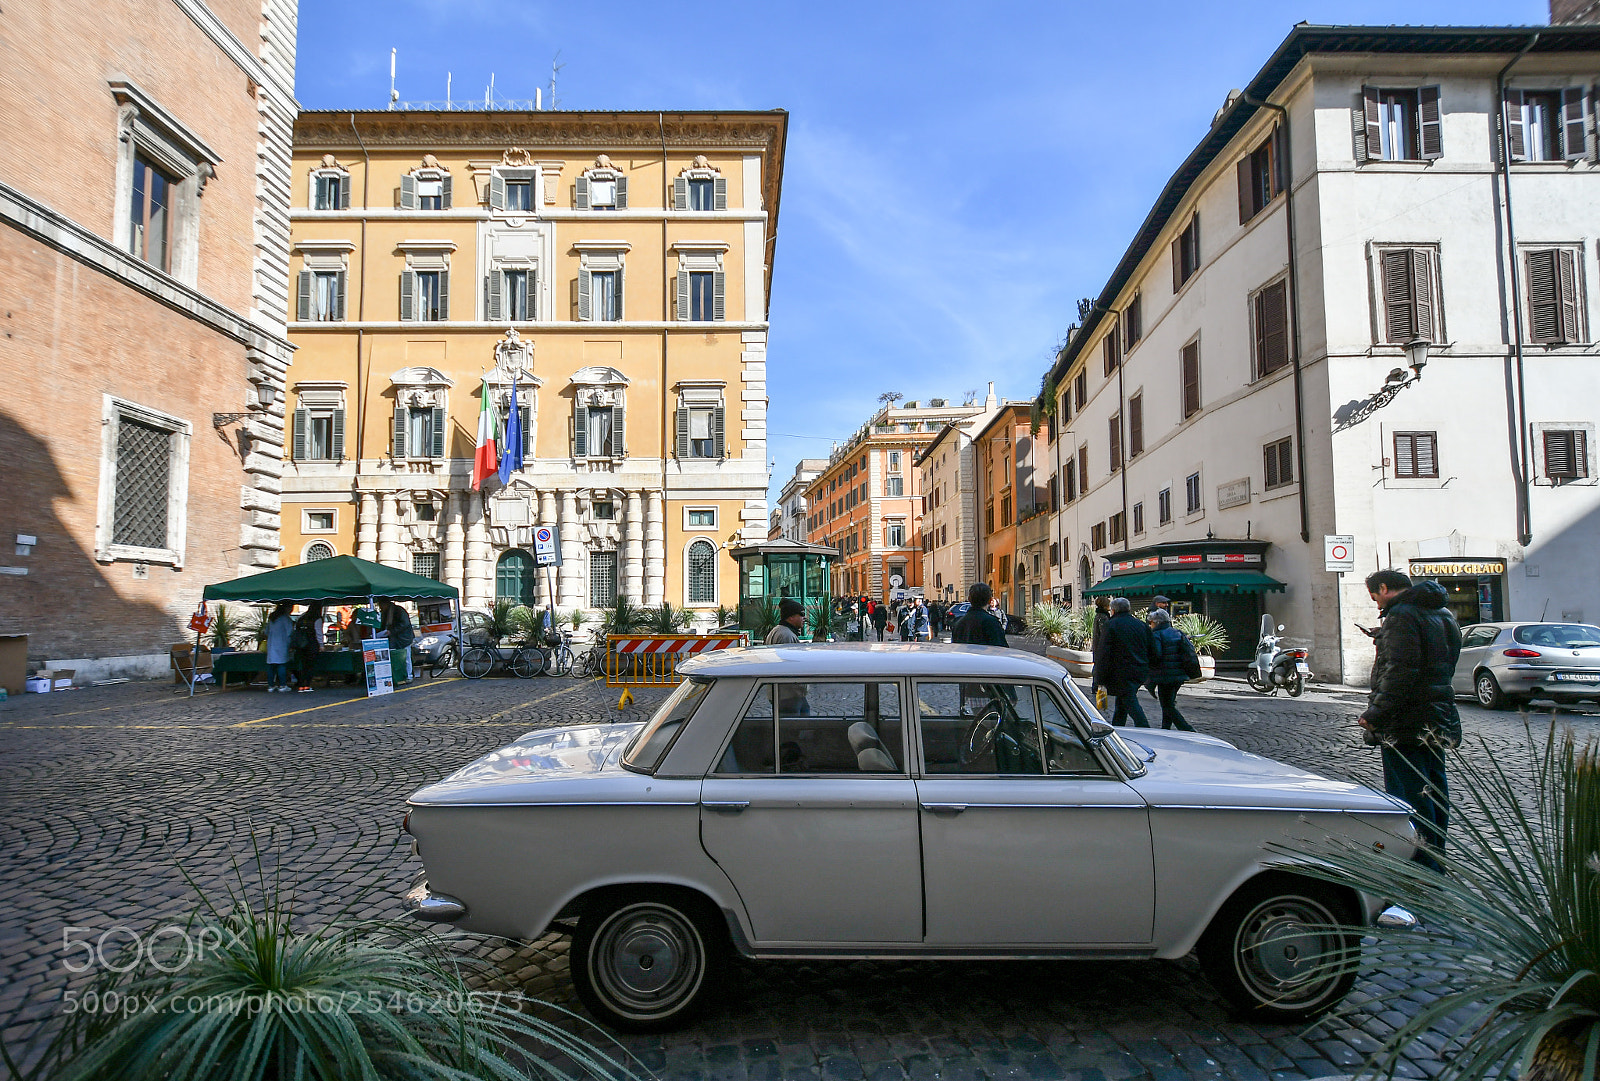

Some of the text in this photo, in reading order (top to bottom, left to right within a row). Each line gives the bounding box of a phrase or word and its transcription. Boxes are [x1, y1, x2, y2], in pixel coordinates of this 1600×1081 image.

[1104, 563, 1111, 577] P
[1424, 563, 1504, 574] PUNTO GELATO
